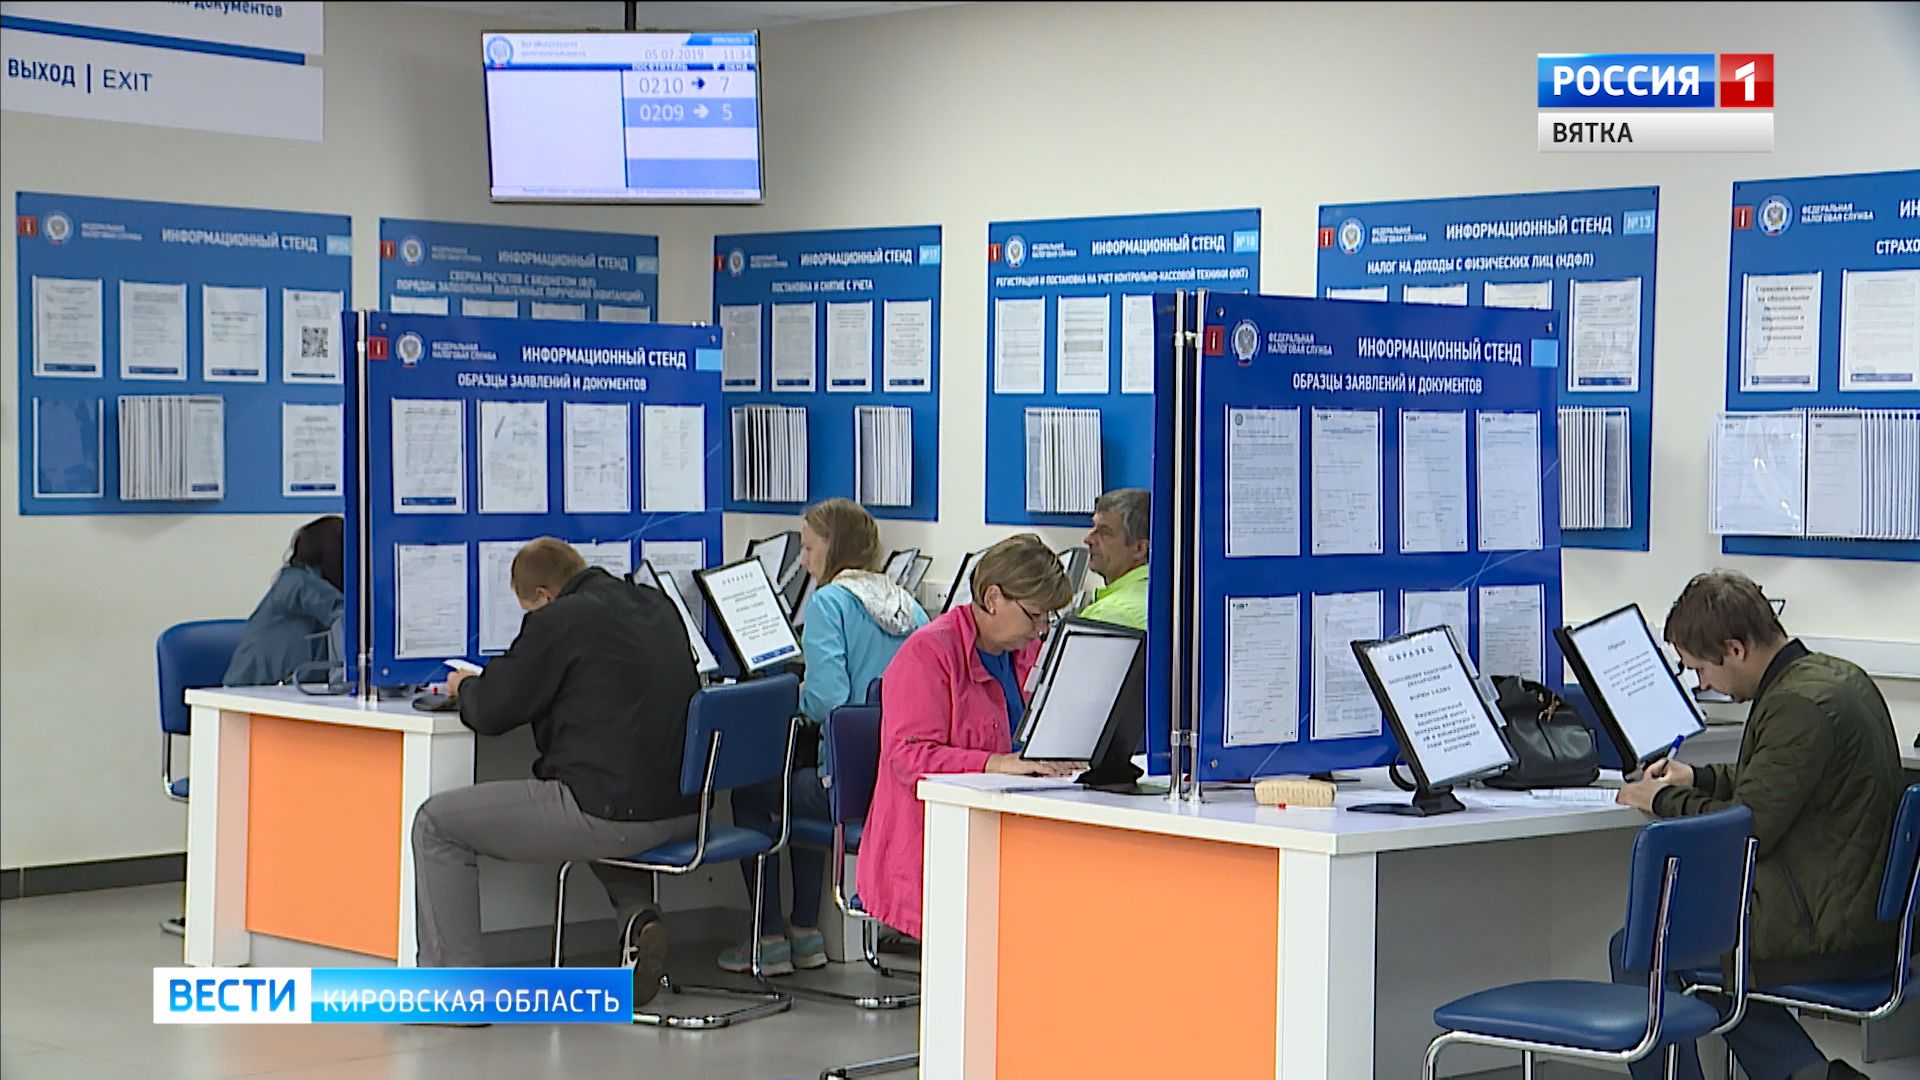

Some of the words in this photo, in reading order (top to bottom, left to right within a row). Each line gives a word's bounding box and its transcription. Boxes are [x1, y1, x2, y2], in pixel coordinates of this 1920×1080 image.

[644, 49, 704, 60] 05.07.2019
[8, 58, 75, 87] ВЫХОД
[103, 69, 152, 92] EXIT
[640, 77, 683, 94] 0210
[720, 77, 729, 93] 7
[640, 104, 685, 121] 0209
[722, 103, 733, 121] 5
[1446, 215, 1568, 240] ИНФОРМАЦИОННЫЙ
[1571, 215, 1613, 236] СТЕНД
[162, 228, 279, 248] ИНФОРМАЦИОННЫЙ
[281, 235, 318, 253] СТЕНД
[1092, 233, 1190, 257] ИНФОРМАЦИОННЫЙ
[1191, 235, 1225, 252] СТЕНД
[499, 249, 596, 268] ИНФОРМАЦИОННЫЙ
[597, 256, 628, 271] СТЕНД
[801, 247, 883, 267] ИНФОРМАЦИОННЫЙ
[884, 249, 912, 264] СТЕНД
[1367, 260, 1397, 274] НАЛОГ
[1398, 260, 1412, 274] НА
[1413, 257, 1454, 275] ДОХОДЫ
[1455, 257, 1463, 271] С
[1464, 254, 1530, 271] ФИЗИЧЕСКИХ
[1532, 253, 1554, 270] ЛИЦ
[1555, 250, 1595, 268] (НДФЛ)
[1087, 273, 1097, 284] НА
[522, 345, 646, 367] ИНФОРМАЦИОННЫЙ
[648, 351, 687, 370] СТЕНД
[1358, 337, 1480, 363] ИНФОРМАЦИОННЫЙ
[1483, 342, 1522, 366] СТЕНД
[458, 373, 507, 389] ОБРАЗЦЫ
[510, 373, 571, 389] ЗАЯВЛЕНИЙ
[573, 375, 581, 389] И
[583, 376, 647, 392] ДОКУМЕНТОВ
[1293, 373, 1343, 393] ОБРАЗЦЫ
[1345, 372, 1406, 393] ЗАЯВЛЕНИЙ
[1408, 375, 1416, 392] И
[1418, 376, 1482, 396] ДОКУМЕНТОВ
